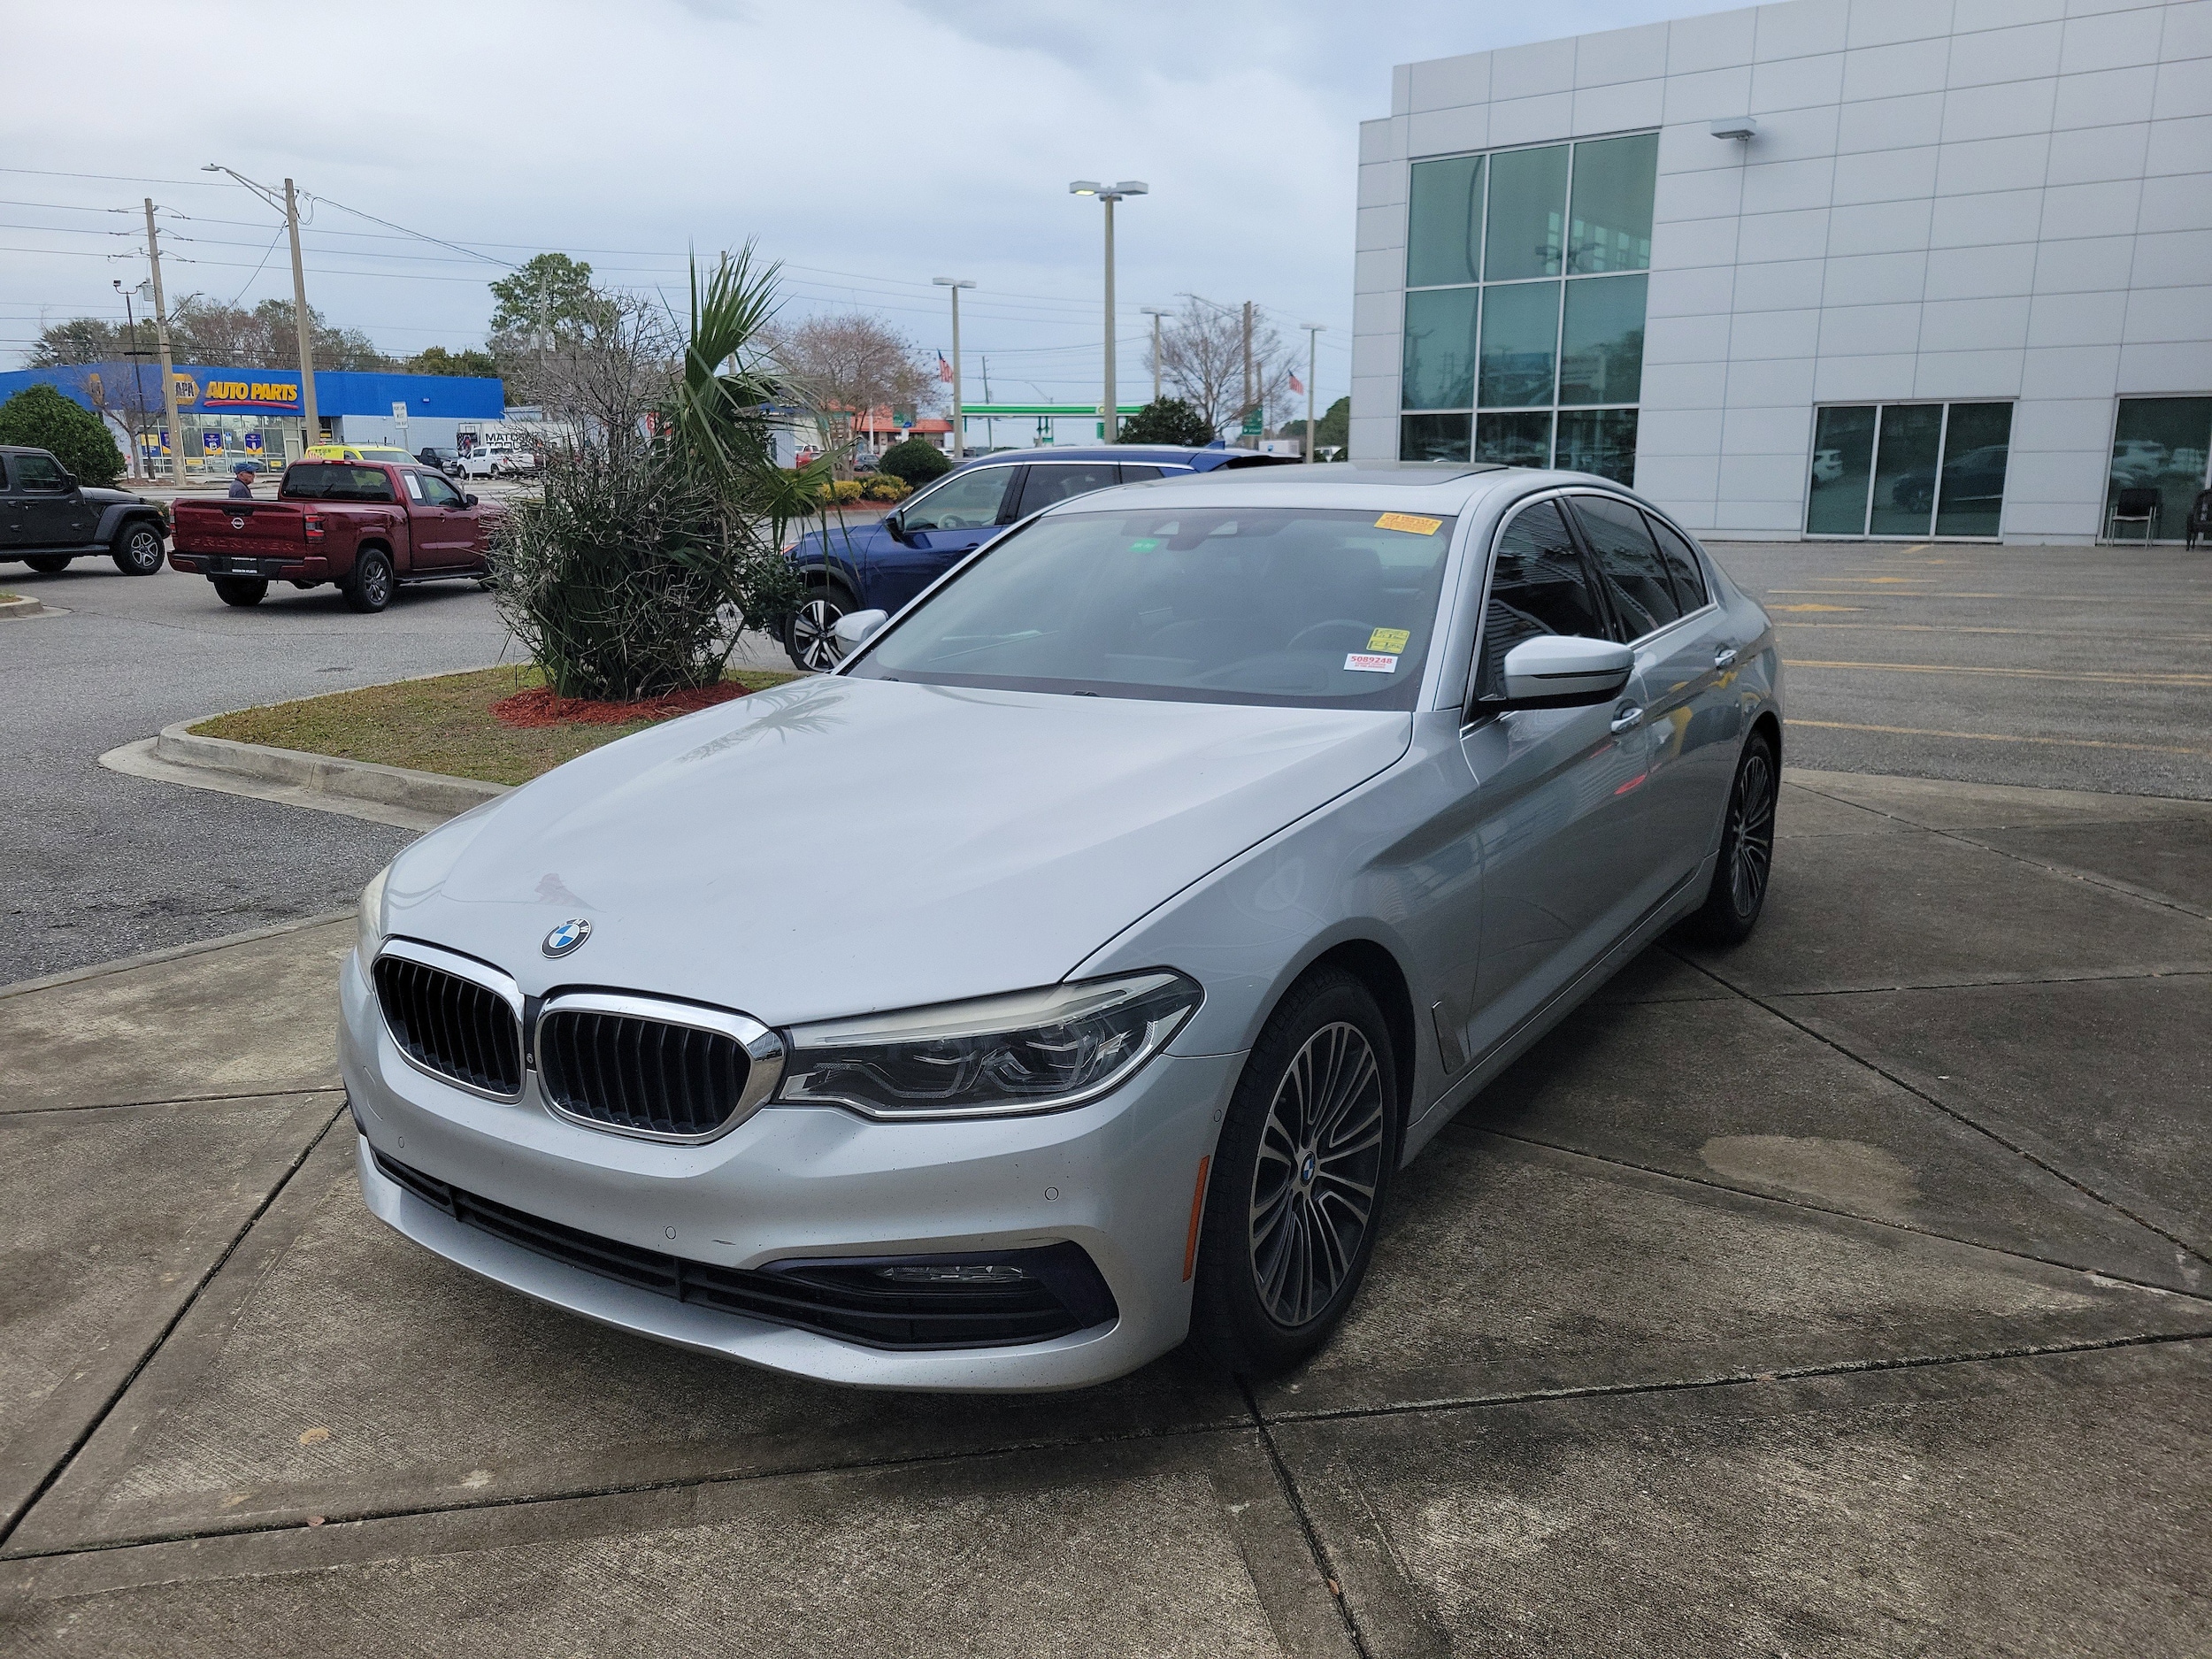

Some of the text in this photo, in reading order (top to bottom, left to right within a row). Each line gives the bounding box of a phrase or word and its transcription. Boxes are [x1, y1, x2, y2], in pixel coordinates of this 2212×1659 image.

[175, 380, 195, 397] APA
[205, 380, 298, 402] AUTO PARTS
[190, 536, 295, 551] FRONTIER
[1350, 656, 1393, 664] 5089248
